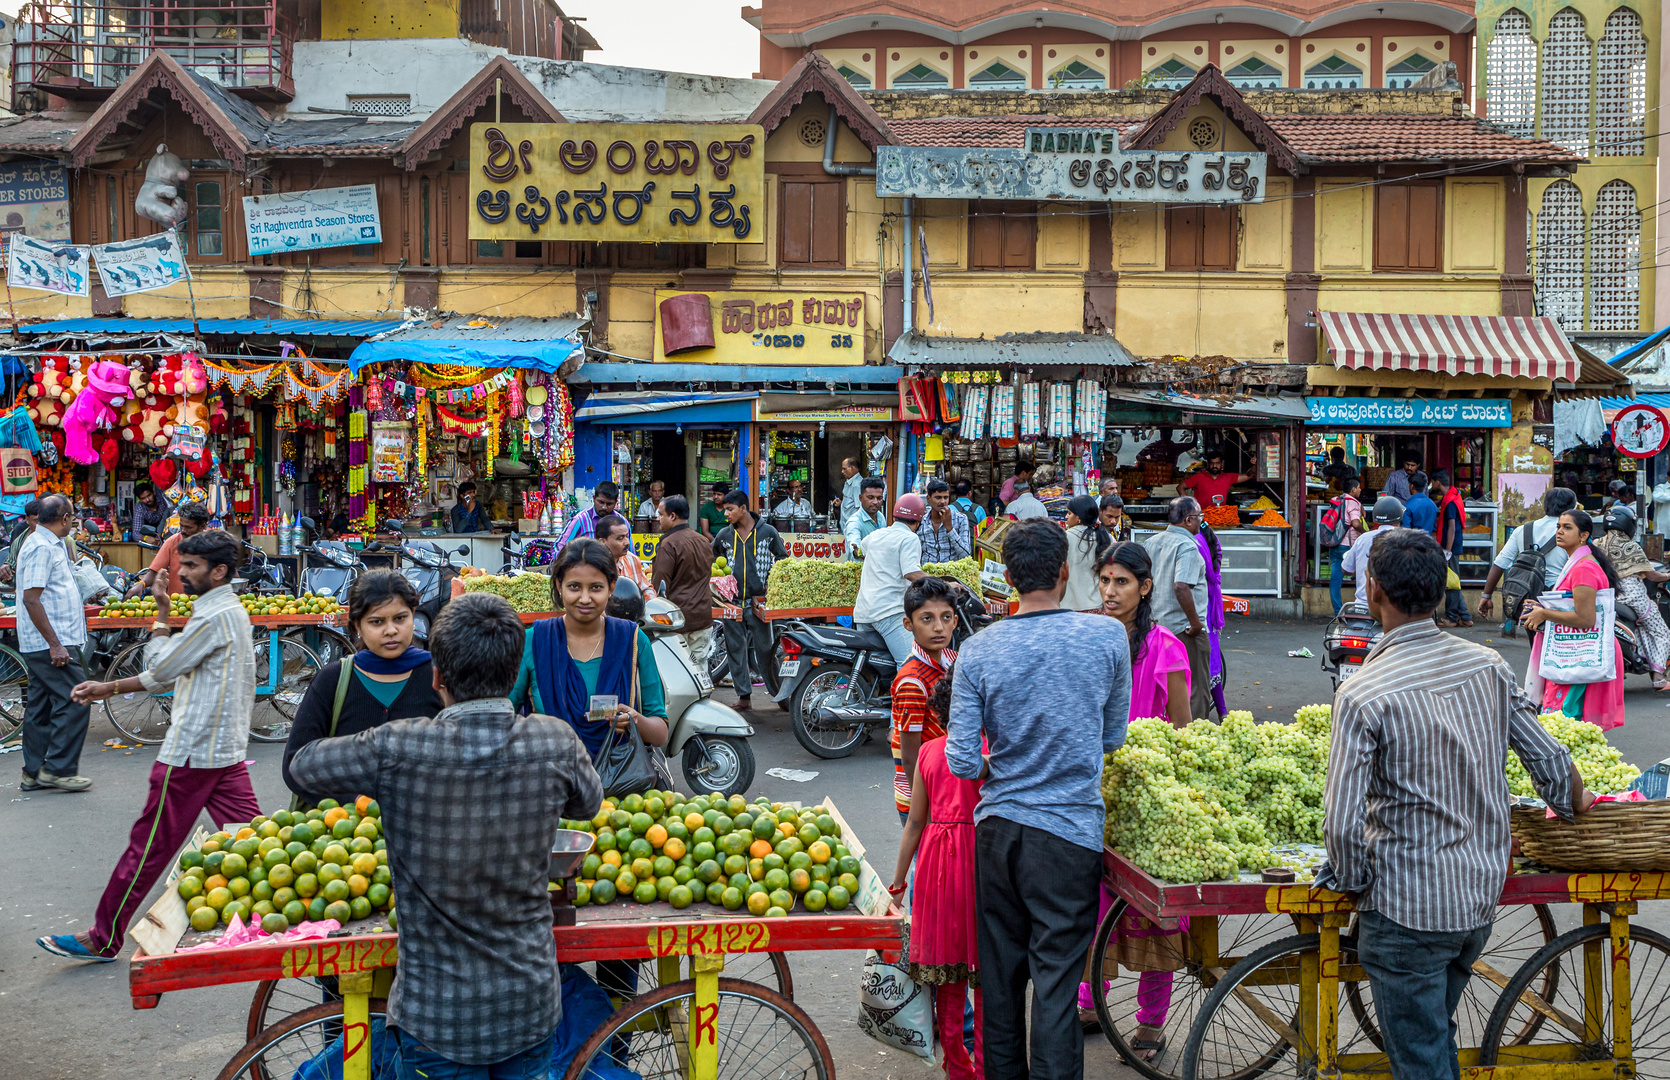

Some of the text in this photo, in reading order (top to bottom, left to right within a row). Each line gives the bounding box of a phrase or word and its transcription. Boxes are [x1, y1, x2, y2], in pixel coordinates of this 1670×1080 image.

[1031, 132, 1114, 154] RADHA'S
[483, 128, 755, 183] ಶ್ರೀ ಅಂಬಾಳ್
[1202, 156, 1259, 201] ನಶ್ಯ
[19, 186, 65, 201] STORES
[669, 184, 751, 238] ನಶ್ಯ
[250, 213, 375, 234] Sri Raghvendra Season Stores
[27, 250, 55, 263] EAG
[110, 250, 147, 264] EAGLE
[722, 297, 862, 334] ಹಾರುವ ಕುದುರೆ
[382, 366, 515, 404] HAPPY BIRTHDAY
[1311, 403, 1326, 421] ಶ್ರೀ
[7, 467, 32, 478] STOP
[723, 608, 738, 619] 194
[1231, 600, 1248, 612] 369
[322, 614, 335, 625] 62
[1612, 944, 1630, 973] K
[696, 1003, 718, 1049] R
[344, 1022, 368, 1062] D
